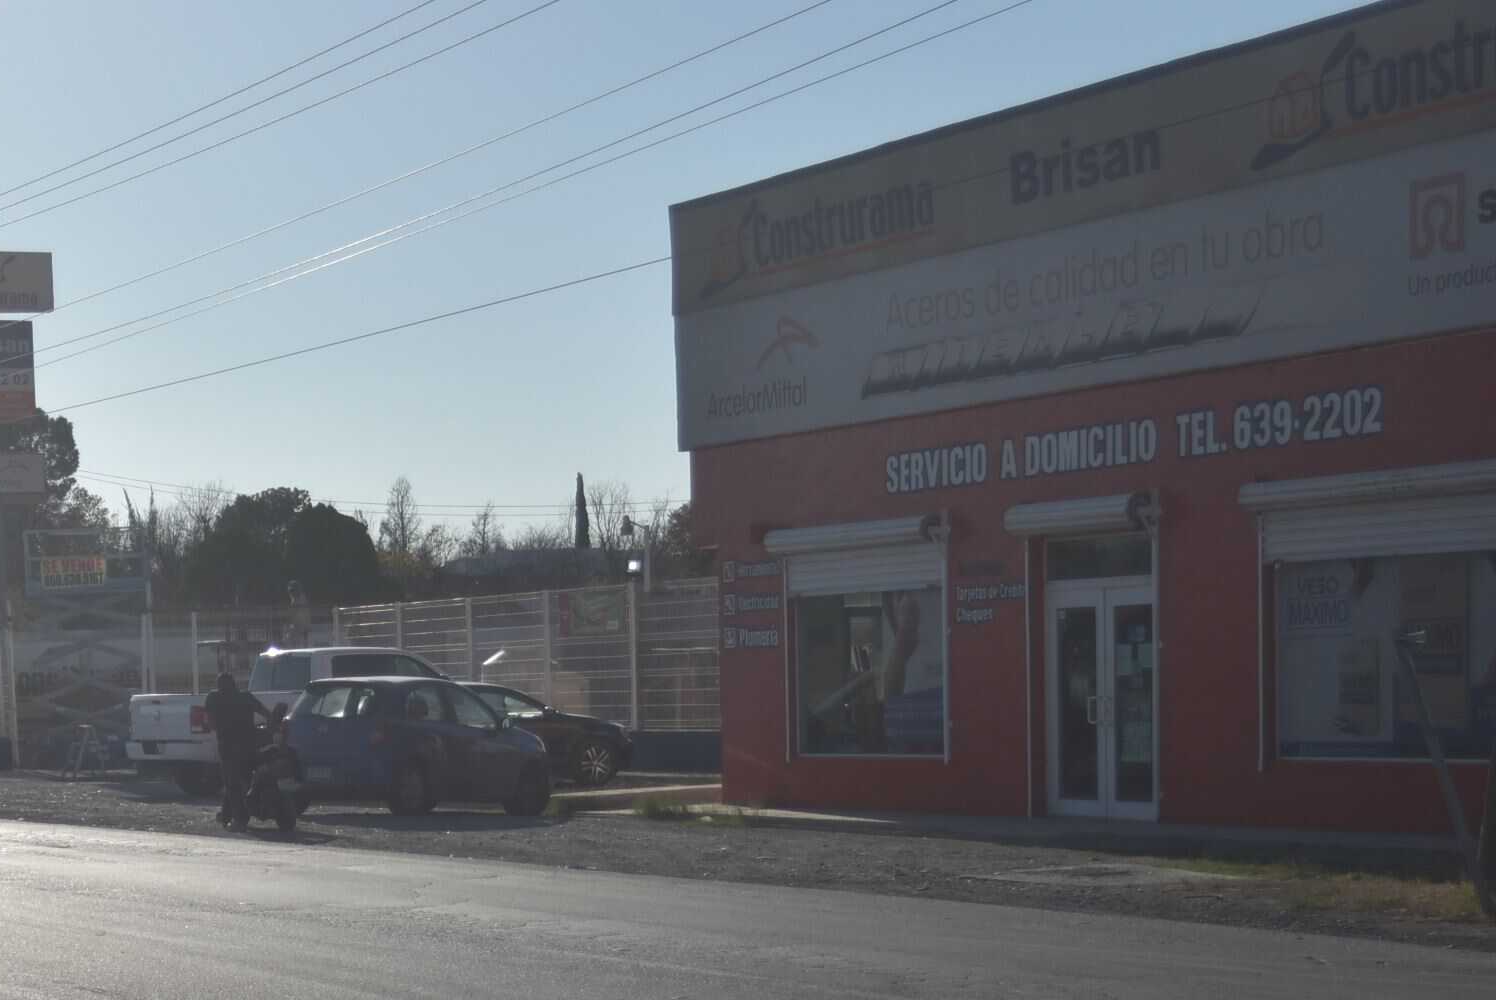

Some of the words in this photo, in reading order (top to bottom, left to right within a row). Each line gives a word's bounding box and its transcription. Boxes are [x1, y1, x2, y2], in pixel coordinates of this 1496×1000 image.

[1344, 19, 1496, 119] Constr
[1009, 127, 1160, 206] Brisan
[753, 178, 935, 266] Construrama
[885, 286, 976, 334] Aceros
[985, 268, 1019, 316] de
[1028, 239, 1140, 305] calidad
[1149, 241, 1189, 281] en
[1201, 224, 1230, 270] tu
[1241, 208, 1324, 264] obra
[13, 373, 30, 384] 02
[705, 376, 808, 422] ArcelorMittal
[885, 443, 987, 494] SERVICIO
[1000, 438, 1018, 480] A
[1024, 419, 1157, 477] DOMICILIO
[1175, 411, 1228, 457] TEL.
[954, 607, 993, 624] Cheques
